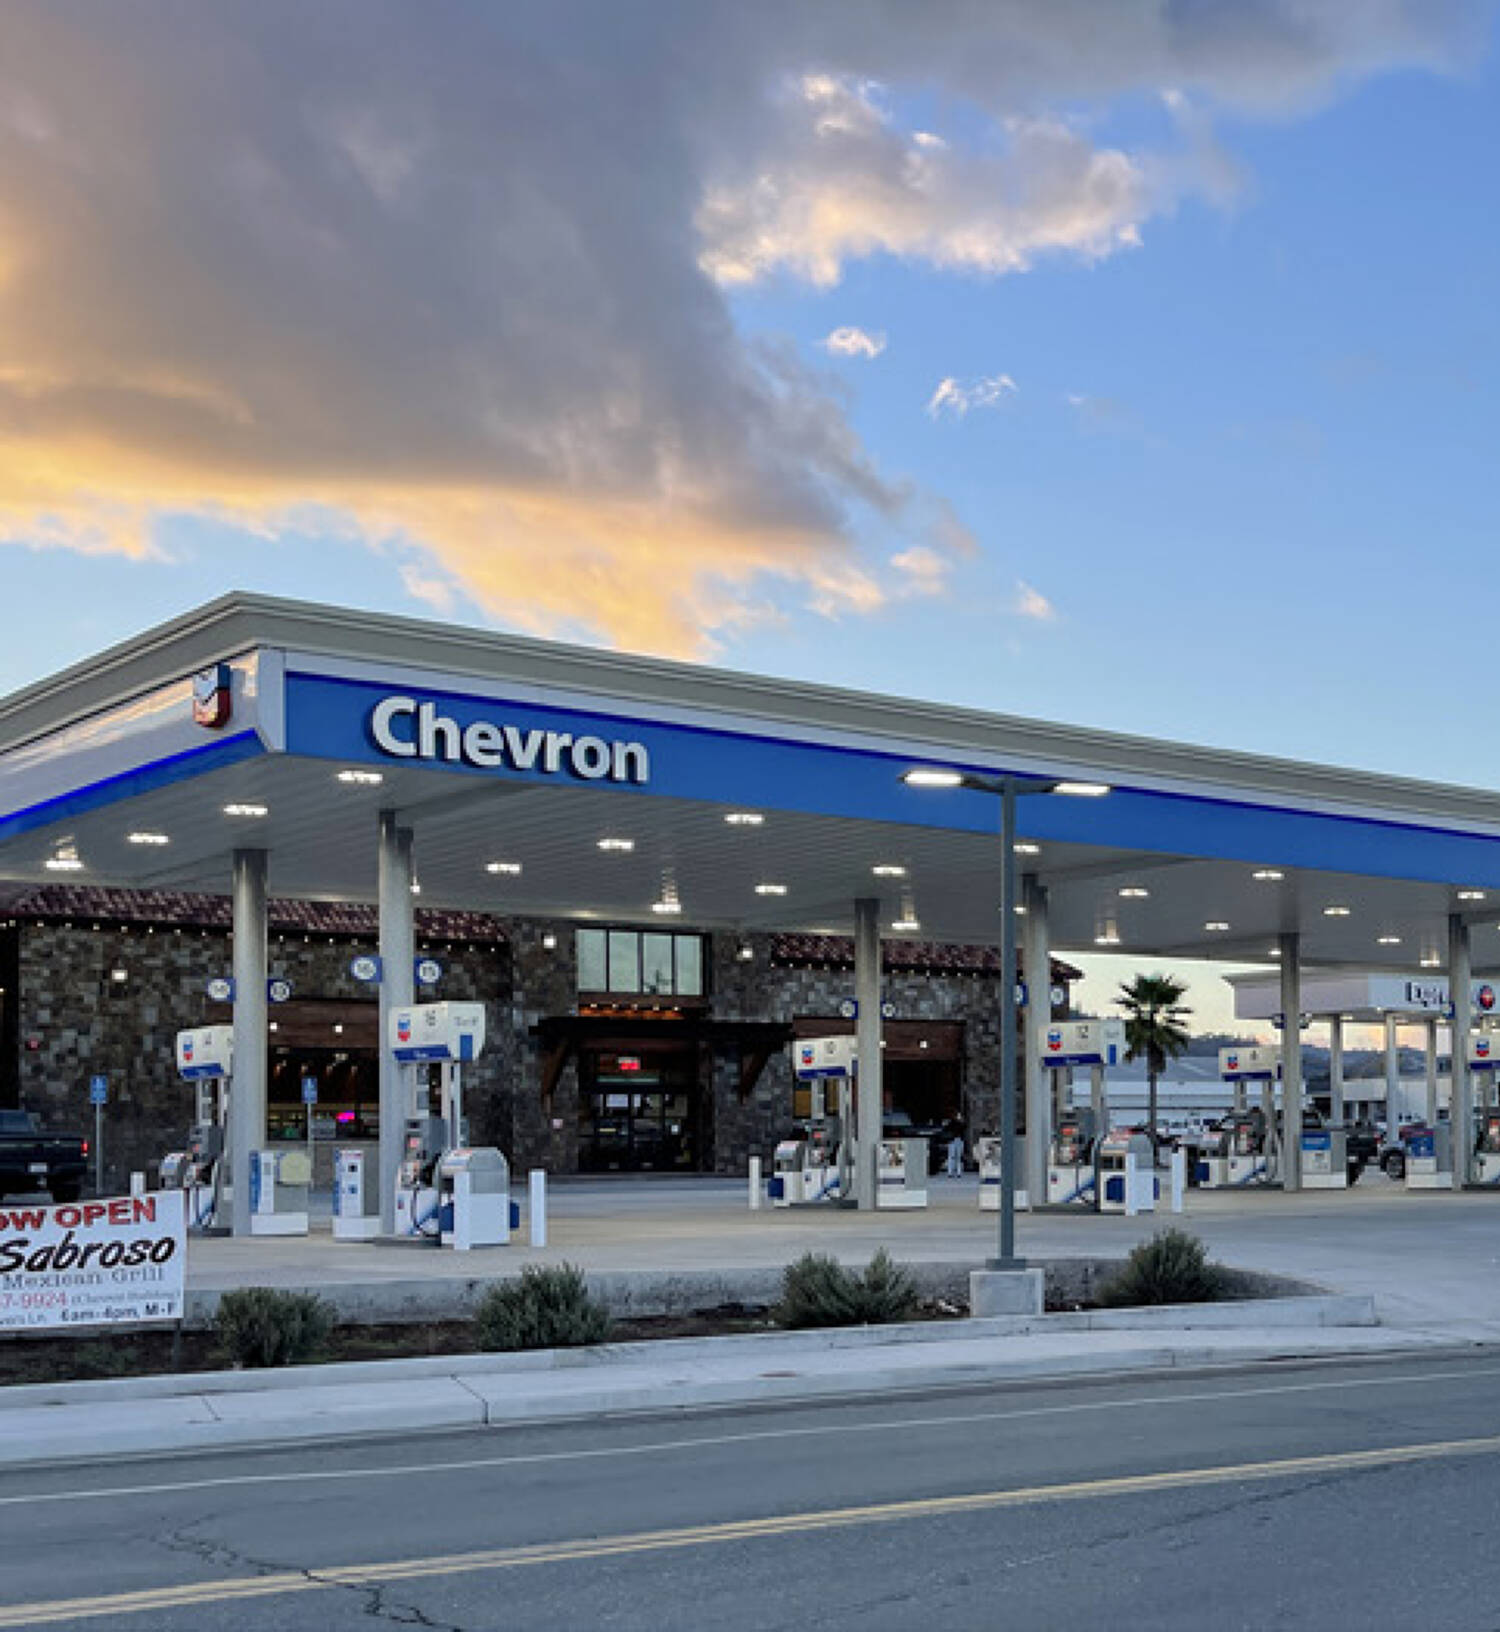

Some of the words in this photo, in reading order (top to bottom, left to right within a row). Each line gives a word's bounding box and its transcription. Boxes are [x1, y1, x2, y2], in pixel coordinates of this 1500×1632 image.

[371, 696, 650, 783] Chevron
[55, 1197, 157, 1227] OPEN
[0, 1230, 175, 1272] Sabroso
[3, 1272, 103, 1290] Mexican
[112, 1267, 163, 1283] Grill
